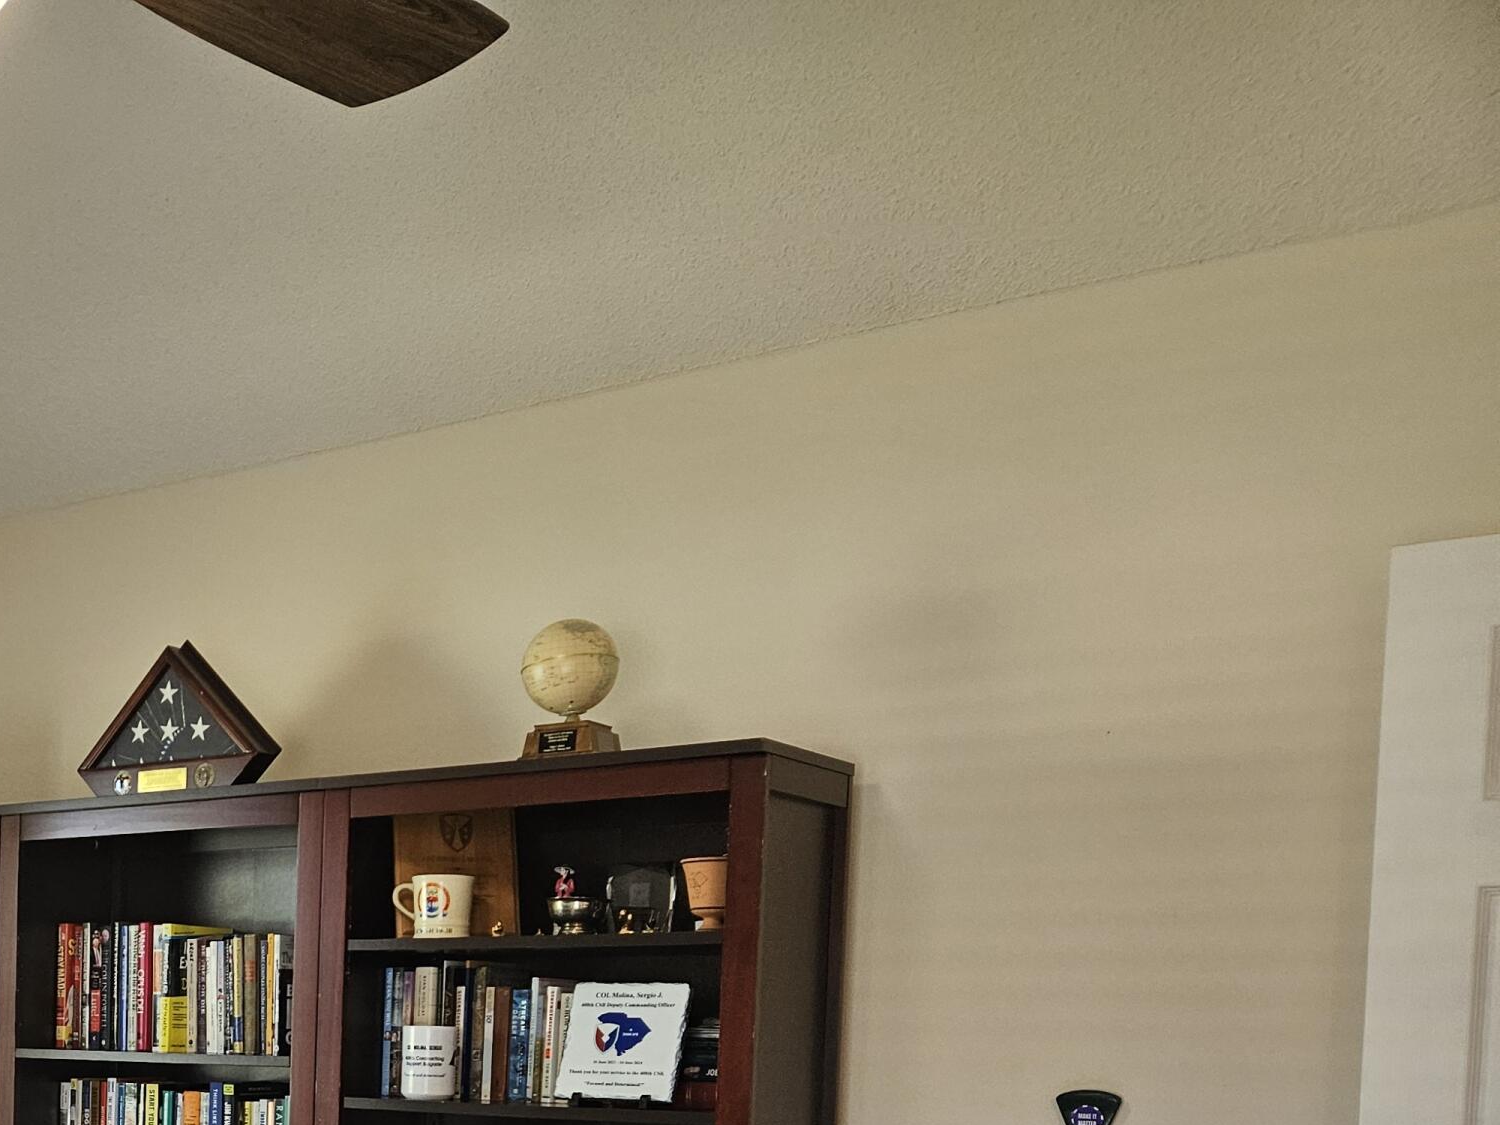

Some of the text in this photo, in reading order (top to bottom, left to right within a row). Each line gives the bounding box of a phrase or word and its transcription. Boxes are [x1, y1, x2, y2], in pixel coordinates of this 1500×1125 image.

[201, 945, 205, 955] BE
[201, 984, 205, 995] OR
[519, 999, 527, 1036] STREAMS
[223, 1101, 231, 1115] JIM
